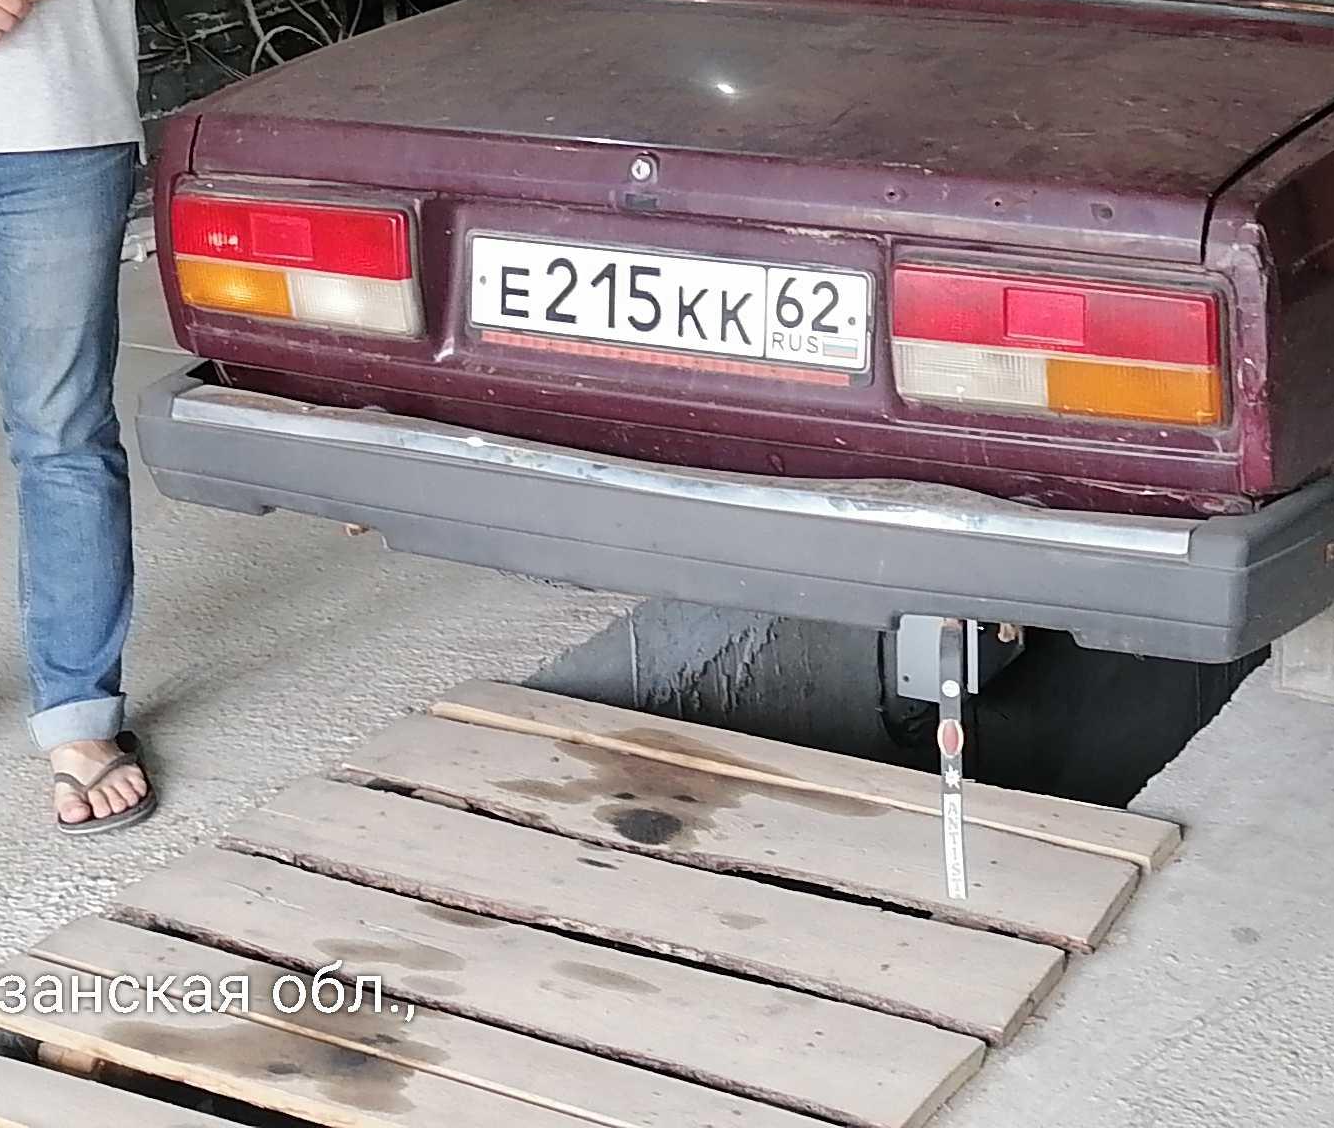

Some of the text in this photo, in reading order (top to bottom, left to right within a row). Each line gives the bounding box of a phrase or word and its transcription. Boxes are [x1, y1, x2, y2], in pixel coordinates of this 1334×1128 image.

[500, 257, 840, 346] Е215КК 62
[771, 331, 820, 355] RUS
